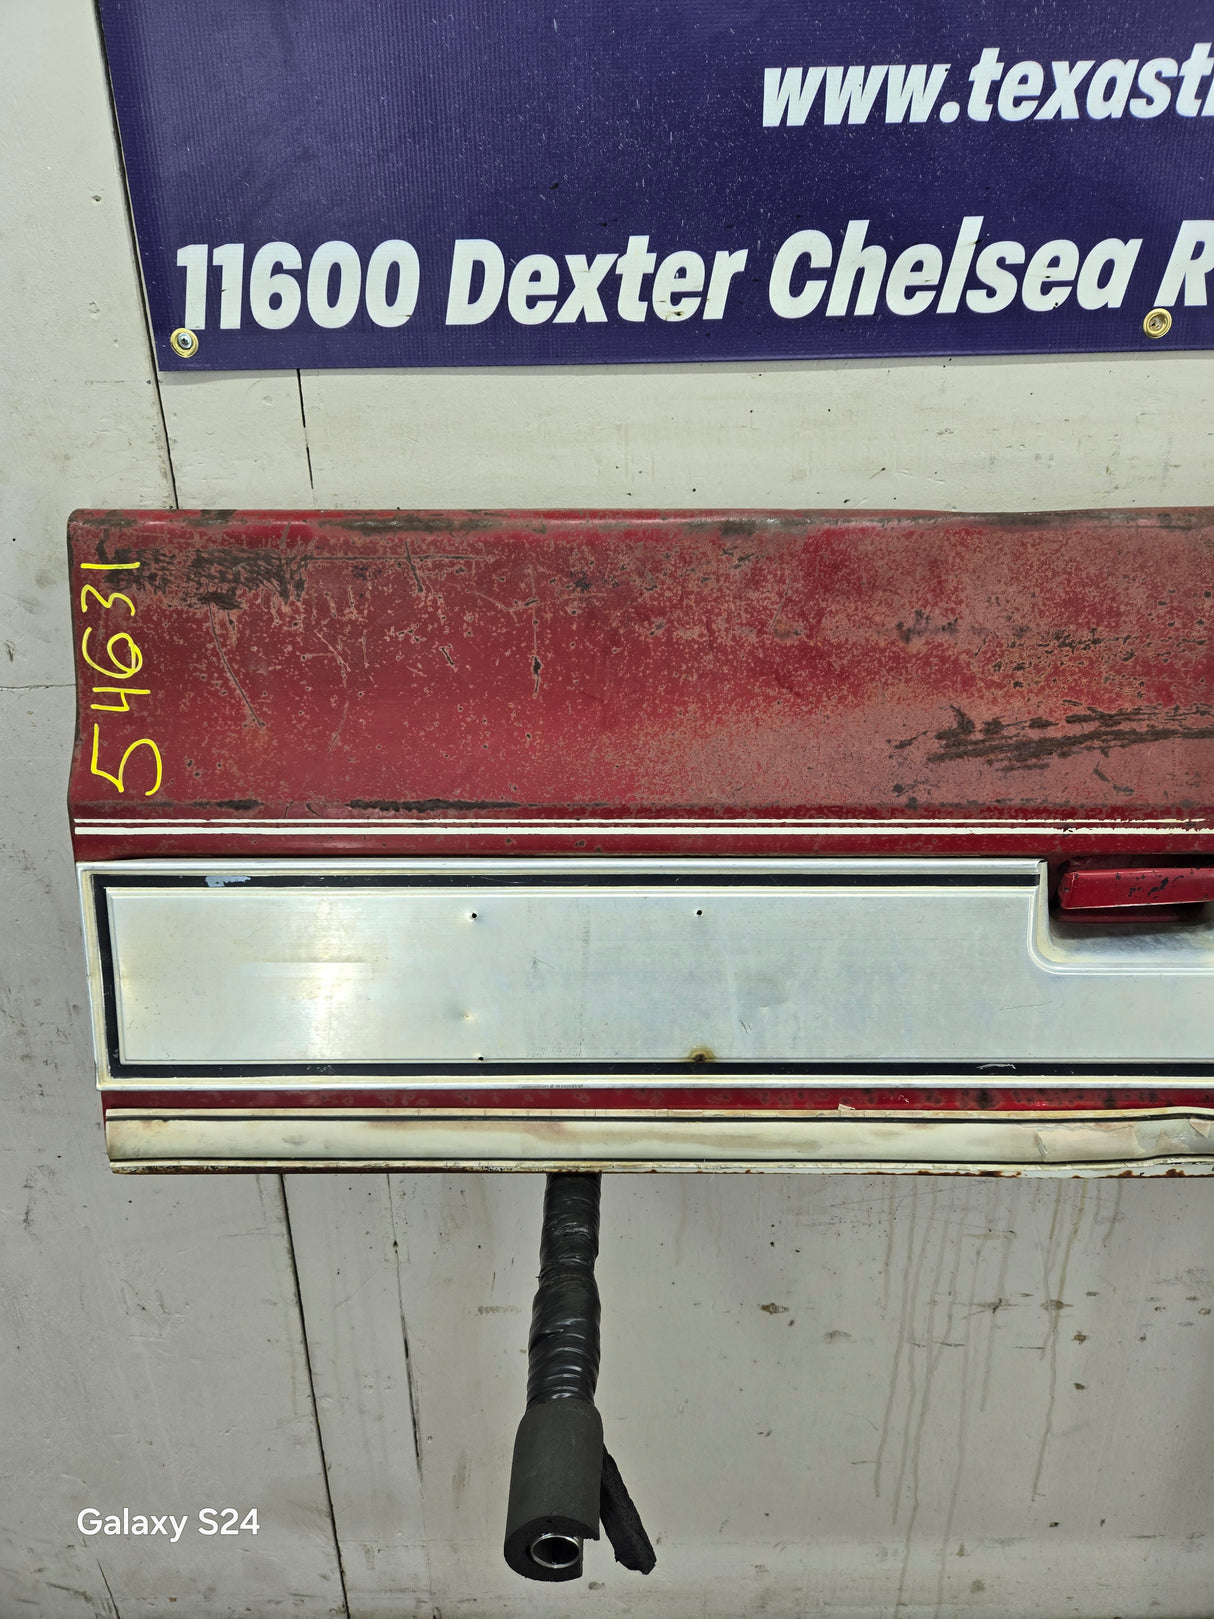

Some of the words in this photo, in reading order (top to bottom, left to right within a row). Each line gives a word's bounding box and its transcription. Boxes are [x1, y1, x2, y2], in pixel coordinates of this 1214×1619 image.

[176, 240, 420, 330] 11600
[445, 235, 748, 326] Dexter
[768, 215, 1143, 319] Chelsea
[80, 561, 163, 796] 54631
